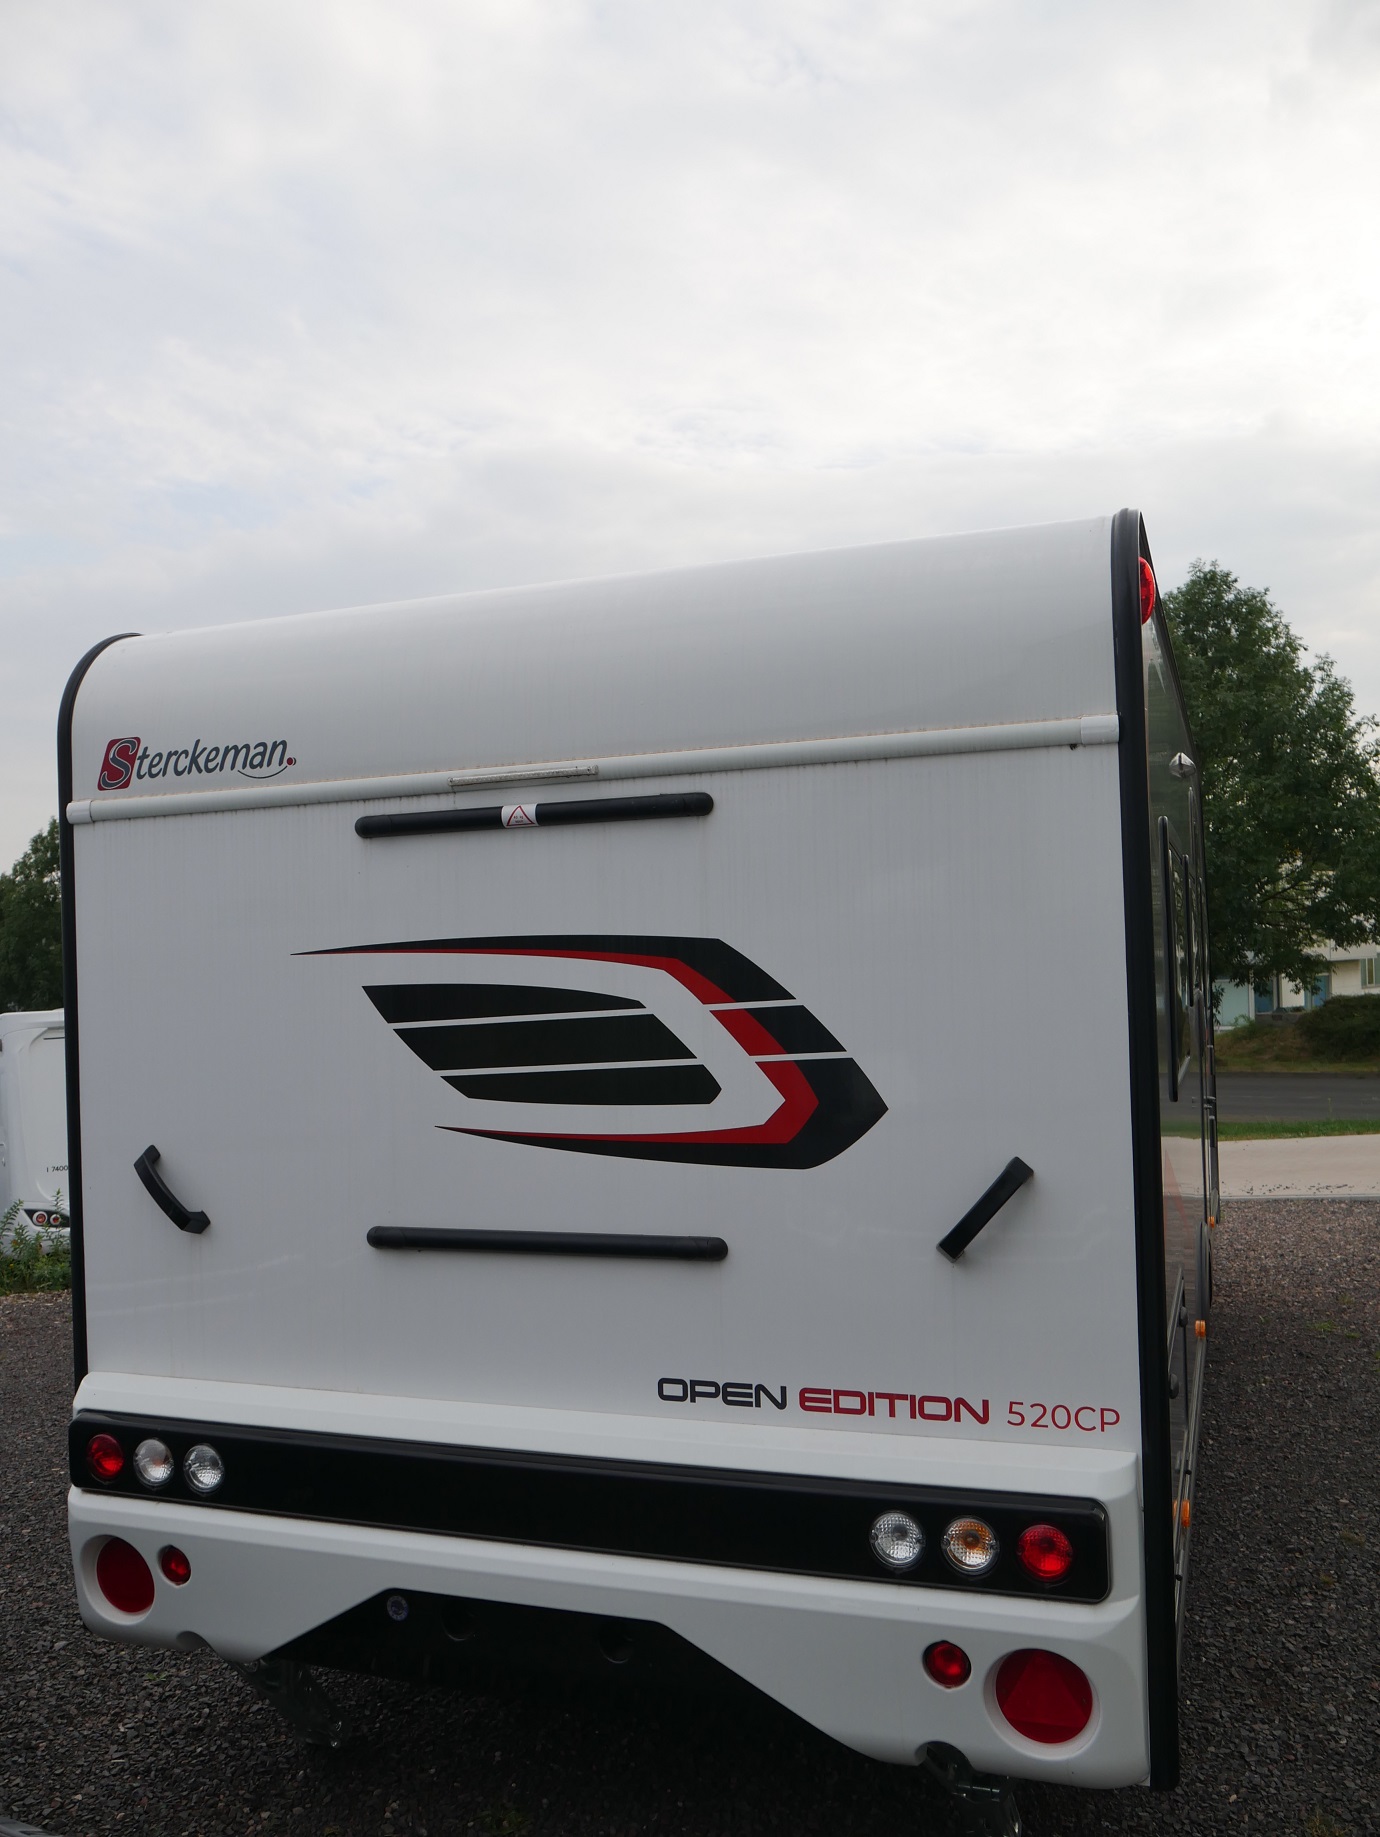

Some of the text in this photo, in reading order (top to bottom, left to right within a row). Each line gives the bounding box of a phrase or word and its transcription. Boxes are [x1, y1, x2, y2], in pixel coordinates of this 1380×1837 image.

[657, 1377, 1121, 1432] OPEN EDITION 520CP
